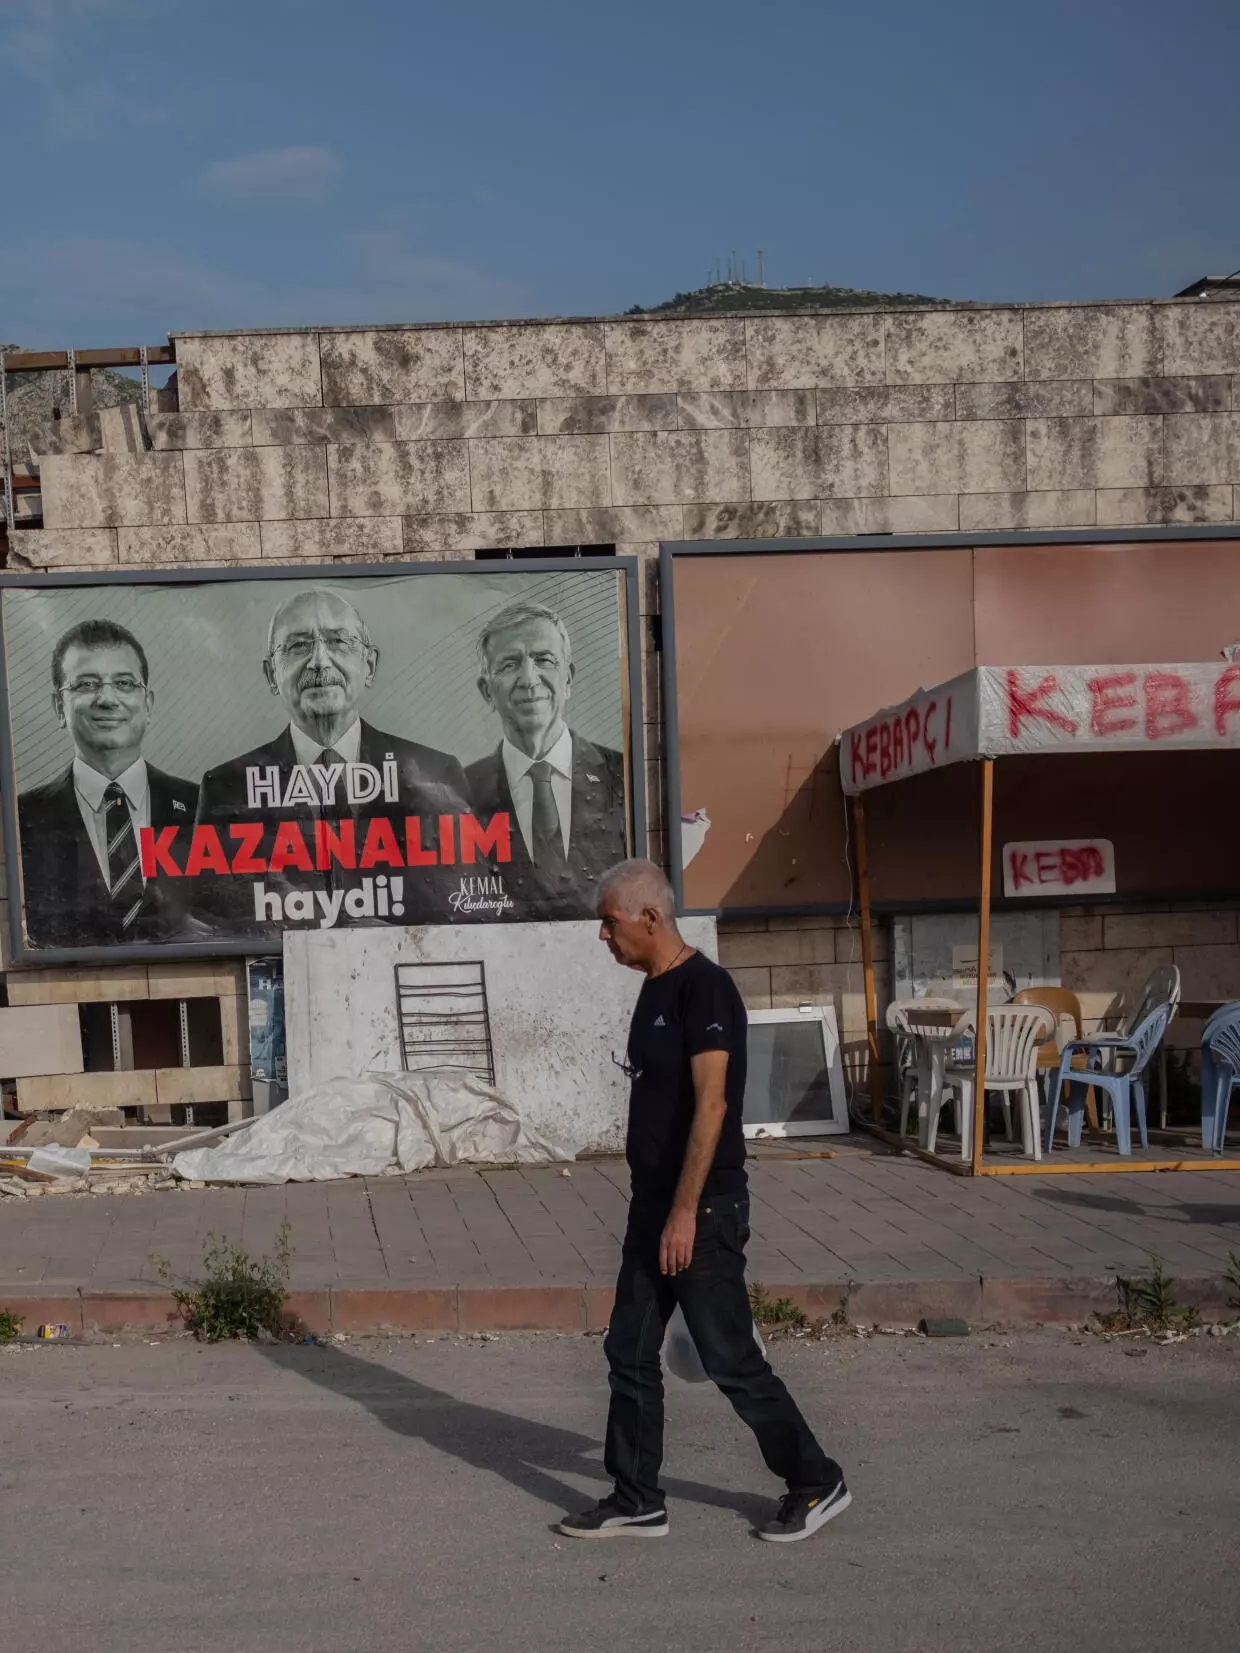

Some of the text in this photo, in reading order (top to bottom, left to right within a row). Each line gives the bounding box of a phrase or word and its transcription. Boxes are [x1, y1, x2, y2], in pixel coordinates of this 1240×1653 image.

[850, 695, 952, 784] KEBAPÇI
[245, 752, 400, 808] HAYDİ
[140, 812, 511, 878] KAZANALIM
[254, 875, 405, 928] haydi!
[460, 875, 506, 896] KEMAL
